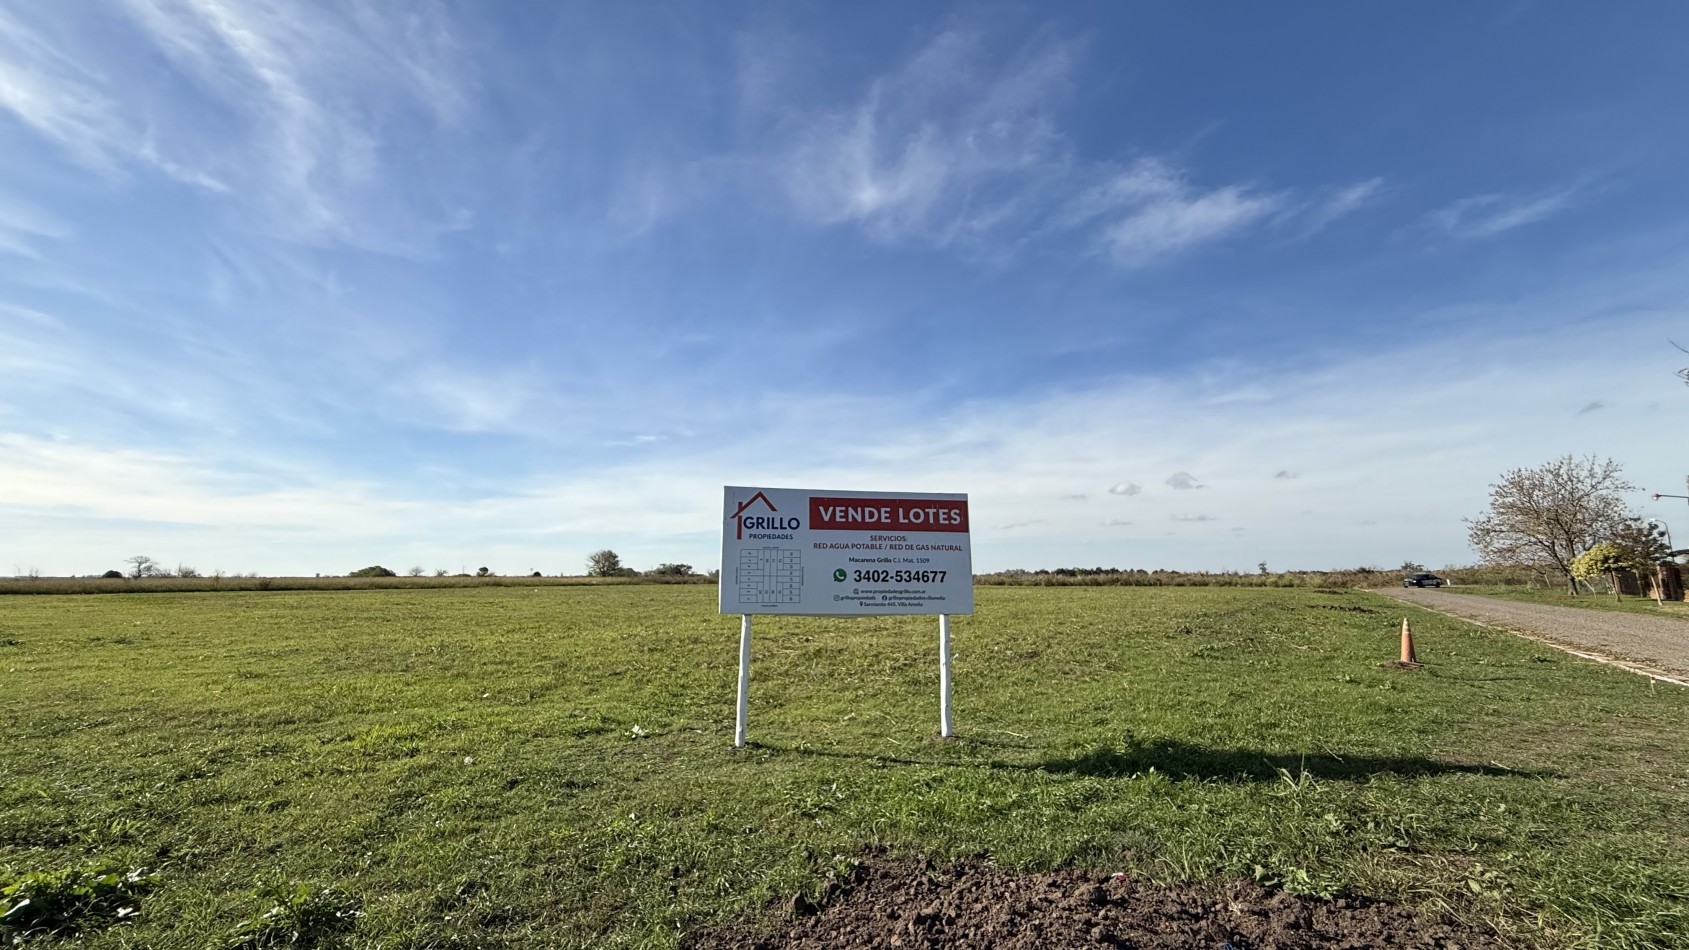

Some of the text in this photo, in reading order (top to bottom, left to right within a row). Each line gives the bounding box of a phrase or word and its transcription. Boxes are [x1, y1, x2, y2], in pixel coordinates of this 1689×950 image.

[818, 505, 961, 525] VENDE LOTES
[743, 516, 800, 531] GRILLO
[931, 544, 963, 552] NATURAL
[853, 570, 947, 583] 3402-534677
